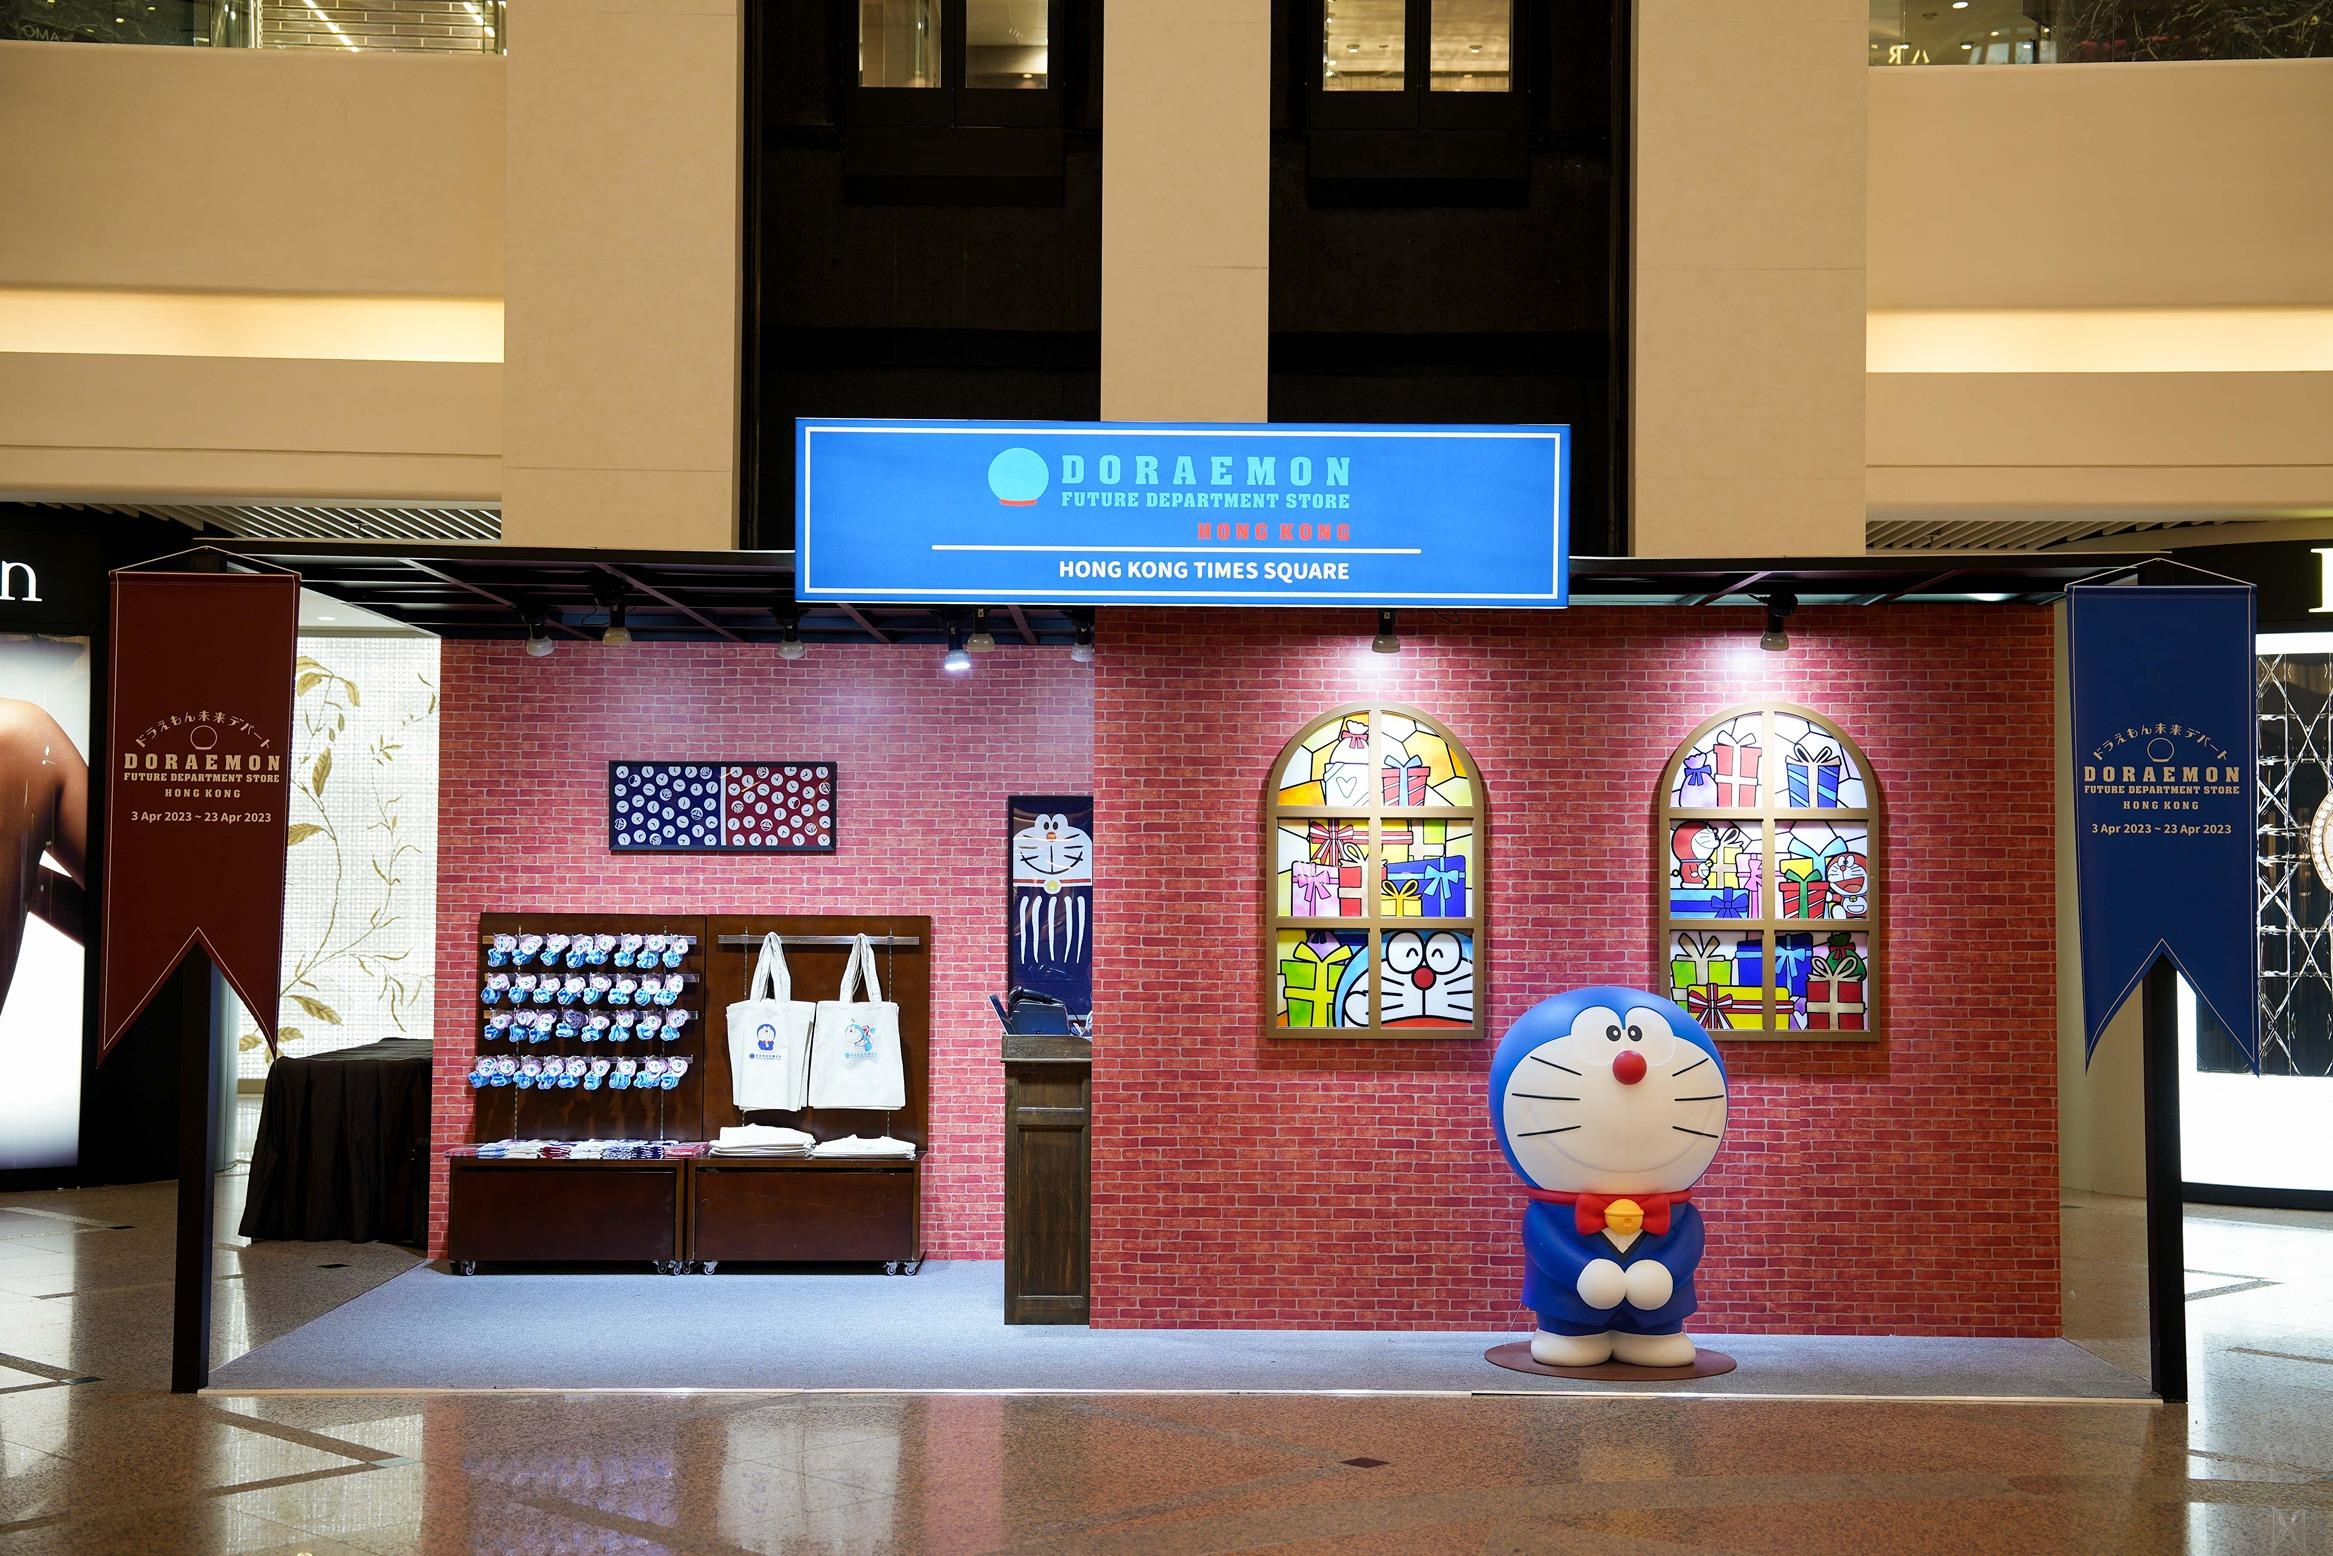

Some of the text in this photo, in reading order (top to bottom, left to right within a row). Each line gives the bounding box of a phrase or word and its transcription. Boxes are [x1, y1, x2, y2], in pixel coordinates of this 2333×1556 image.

[1061, 453, 1351, 487] DORAEMON
[1061, 491, 1350, 510] FUTURE DEPARTMENT STORE
[1197, 522, 1350, 541] HONG KONG
[1060, 560, 1349, 583] HONG KONG TIMES SQUARE
[125, 753, 280, 770] DORAEMON
[124, 772, 279, 782] FUTURE DEPARTMENT STORE
[2085, 766, 2239, 782] DORAEMON
[165, 789, 240, 797] HONG KONG
[2084, 785, 2240, 795] FUTURE DEPARTMENT STORE
[2123, 801, 2199, 810] HONG KONG
[132, 811, 138, 820] 3
[141, 812, 162, 823] Apr
[165, 812, 191, 821] 2023
[204, 812, 218, 821] 23
[221, 813, 241, 824] Apr
[245, 813, 271, 822] 2023
[2092, 824, 2098, 833] 3
[2101, 824, 2121, 835] Apr
[2124, 824, 2151, 833] 2023
[2164, 824, 2177, 833] 23
[2180, 825, 2200, 835] Apr
[2203, 825, 2231, 833] 2023
